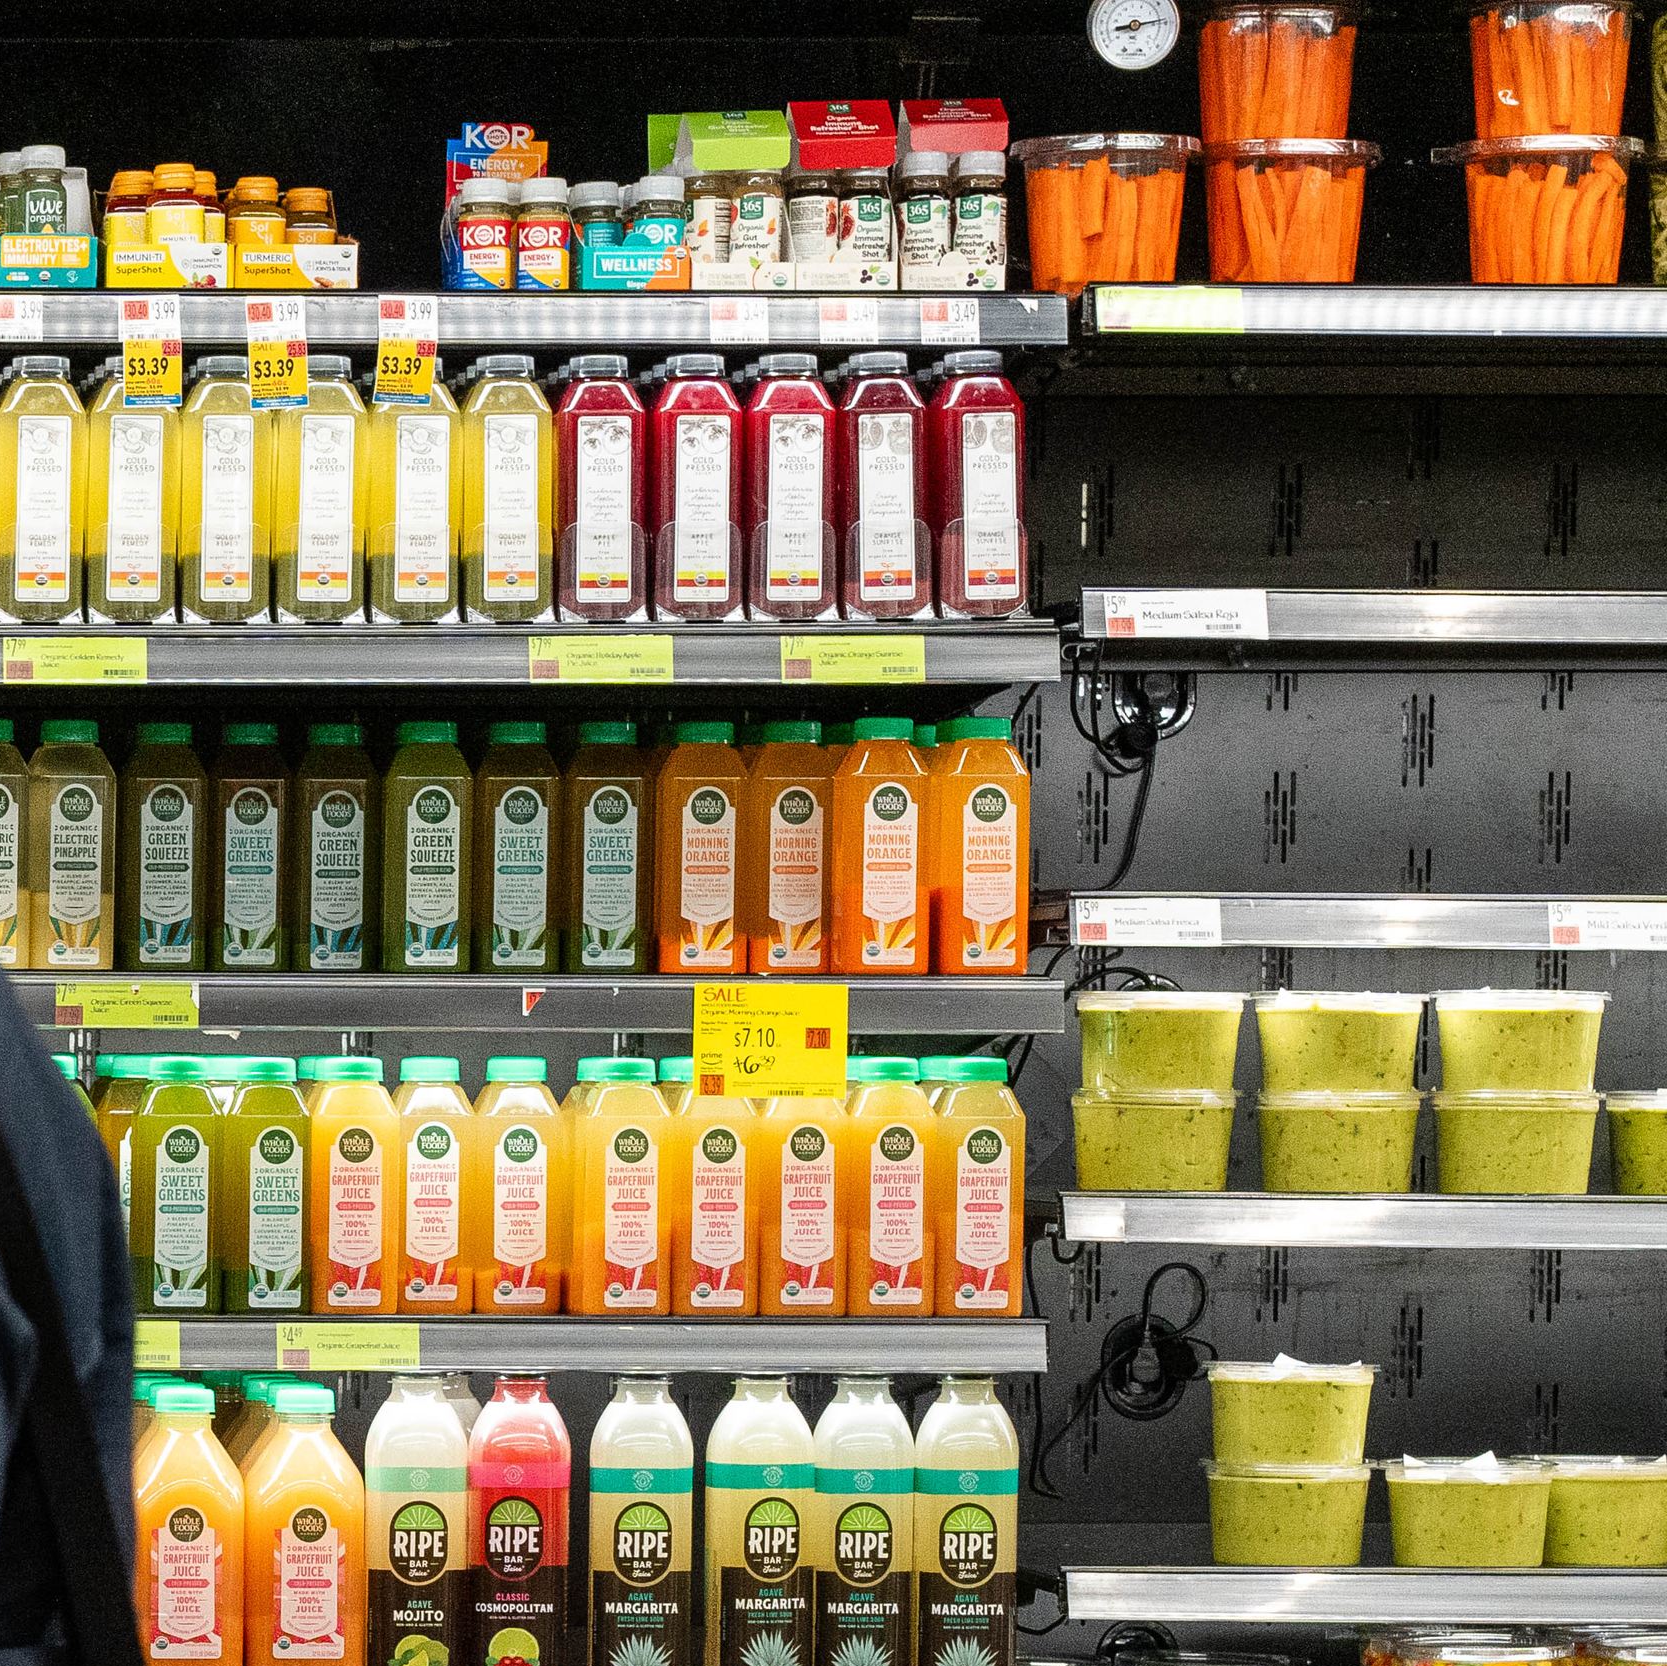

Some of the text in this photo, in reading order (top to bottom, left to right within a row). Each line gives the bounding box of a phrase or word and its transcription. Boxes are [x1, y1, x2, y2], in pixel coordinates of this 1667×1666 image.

[465, 125, 532, 149] KOR
[741, 201, 762, 213] 365
[860, 202, 881, 214] 365
[908, 204, 930, 216] 365
[463, 226, 507, 246] KOR
[4, 240, 87, 254] ELECTROLYTES+
[4, 254, 56, 265] IMMUNITY
[245, 254, 291, 262] TURMERIC
[116, 266, 162, 275] SuperShot
[244, 267, 291, 275] SuperShot
[601, 258, 672, 272] WELLNESS
[129, 357, 168, 377] $3.39
[254, 360, 294, 379] $3.39
[382, 356, 422, 376] $3.39
[1142, 610, 1181, 620] Medium
[1183, 610, 1213, 620] Salsa
[148, 833, 187, 845] GREEN
[230, 836, 272, 849] SWEET
[413, 836, 453, 848] GREEN
[687, 837, 729, 849] MORNING
[868, 834, 911, 846] MORNING
[145, 847, 190, 861] SQUEEZE
[228, 850, 274, 863] GREENS
[411, 849, 456, 863] SQUEEZE
[685, 850, 730, 863] ORANGE
[867, 847, 912, 860] ORANGE
[703, 987, 747, 1002] SALE
[735, 1028, 775, 1047] $7.10
[161, 1175, 203, 1188] SWEET
[331, 1174, 380, 1186] GRAPEFRUIT
[960, 1174, 1008, 1187] GRAPEFRUIT
[159, 1189, 206, 1202] GREENS
[342, 1188, 371, 1199] JUICE
[970, 1188, 999, 1200] JUICE
[394, 1530, 445, 1558] RIPE
[488, 1526, 540, 1553] RIPE
[617, 1531, 669, 1558] RIPE
[748, 1526, 797, 1554] RIPE
[839, 1532, 890, 1559] RIPE
[944, 1532, 994, 1560] RIPE
[163, 1552, 209, 1565] GRAPEFRUIT
[409, 1560, 428, 1568] BAR
[633, 1560, 652, 1569] BAR
[172, 1566, 201, 1577] JUICE
[495, 1592, 530, 1601] CLASSIC
[628, 1592, 654, 1601] AGAVE
[407, 1600, 433, 1610] AGAVE
[475, 1602, 554, 1613] COSMOPOLITAN
[605, 1602, 678, 1614] MARGARITA
[735, 1597, 806, 1610] MARGARITA
[827, 1602, 899, 1615] MARGARITA
[931, 1604, 1004, 1616] MARGARITA
[393, 1610, 444, 1622] MOJITO
